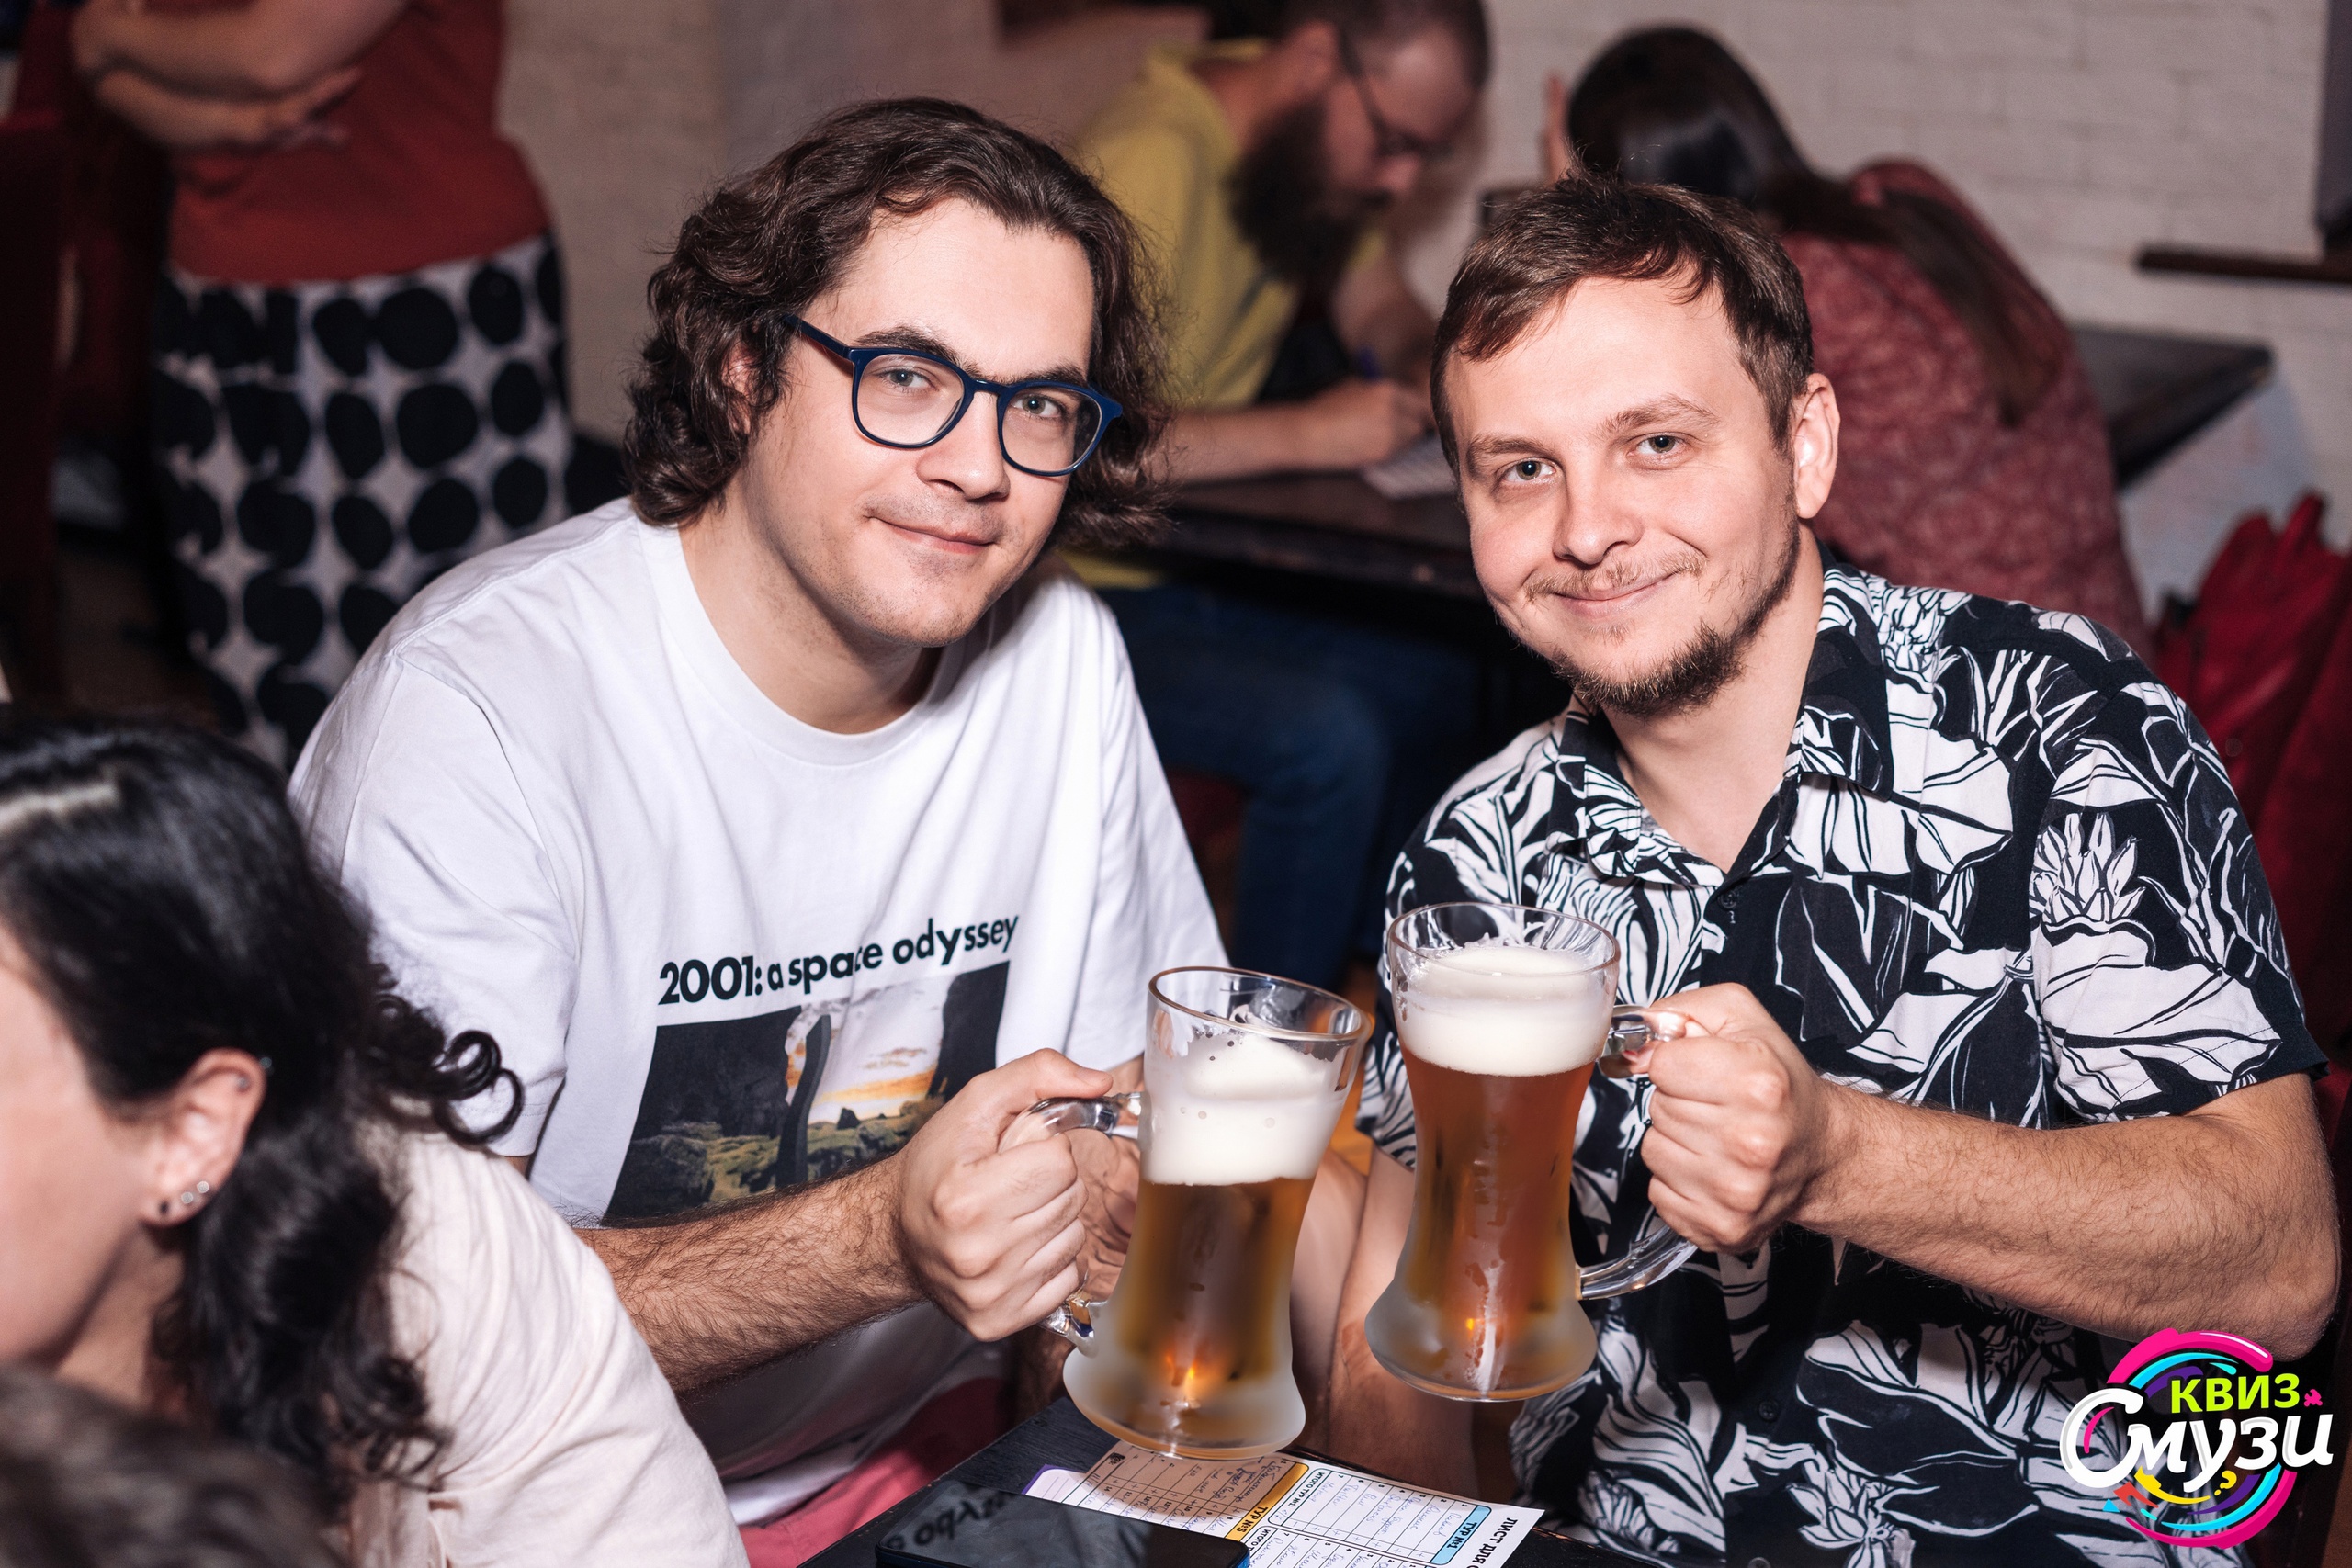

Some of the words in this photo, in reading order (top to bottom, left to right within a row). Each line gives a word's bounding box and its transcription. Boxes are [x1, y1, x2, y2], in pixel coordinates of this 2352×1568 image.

[658, 956, 763, 1005] 2001:
[766, 961, 784, 992] a
[787, 942, 883, 994] space
[892, 916, 1019, 965] odyssey
[1305, 1472, 1324, 1488] ИТОГО
[1295, 1487, 1310, 1497] ТУР
[1250, 1506, 1269, 1521] ТУР
[1236, 1518, 1258, 1533] №5
[1462, 1521, 1477, 1536] ТУР
[1489, 1517, 1518, 1544] ЛИСТ
[1250, 1529, 1270, 1546] ИТОГО
[1472, 1543, 1497, 1565] ДЛЯ
